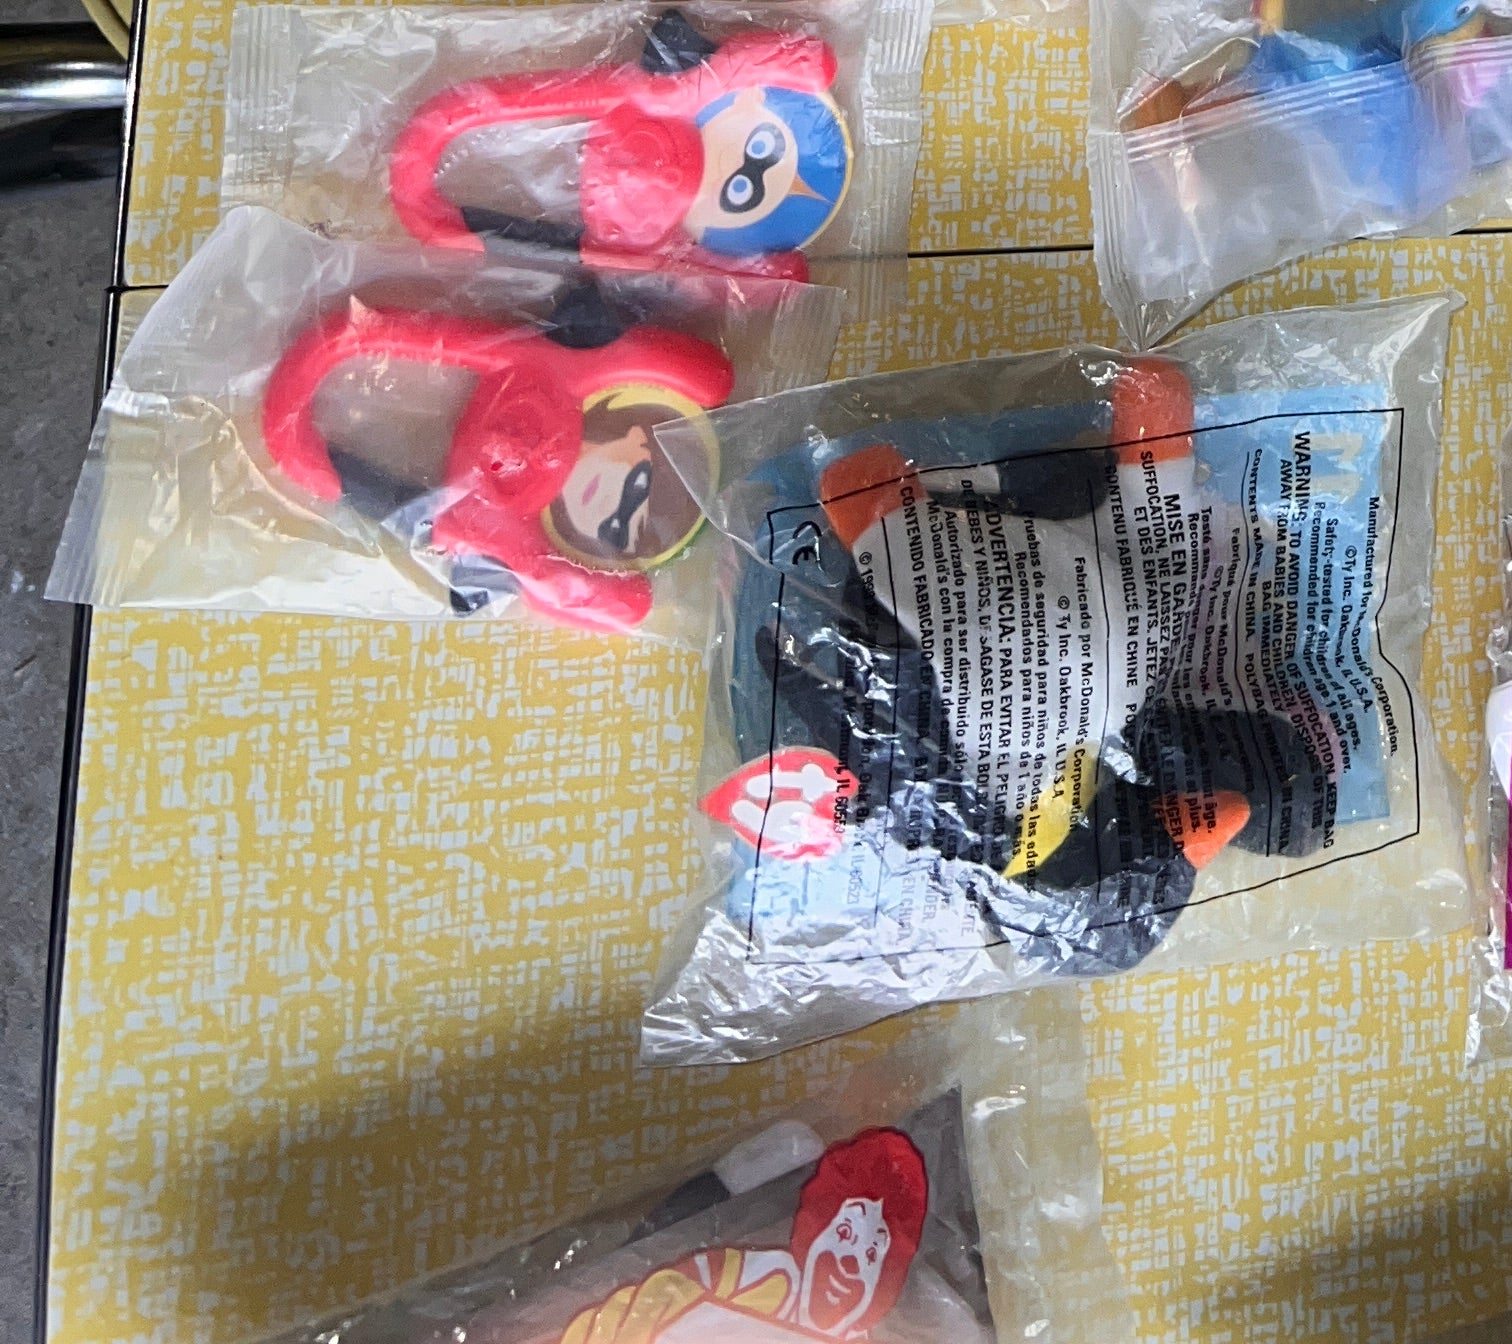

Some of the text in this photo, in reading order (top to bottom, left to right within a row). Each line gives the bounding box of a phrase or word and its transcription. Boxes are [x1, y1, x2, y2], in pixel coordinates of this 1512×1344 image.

[900, 486, 935, 661] CONTENIDO FABRICADO
[1163, 493, 1187, 577] MISE EN
[1273, 545, 1286, 600] BABIES
[1362, 496, 1380, 589] Manufactured
[943, 511, 973, 738] Autorizado distribuido
[1283, 530, 1302, 660] TO AVOID DANGER
[1033, 592, 1050, 749] seguridad para niños
[1054, 634, 1072, 741] Inc. Oakbrook,
[1068, 557, 1094, 832] Fabricado por McDonald's Corporation
[1125, 640, 1139, 688] CHINE
